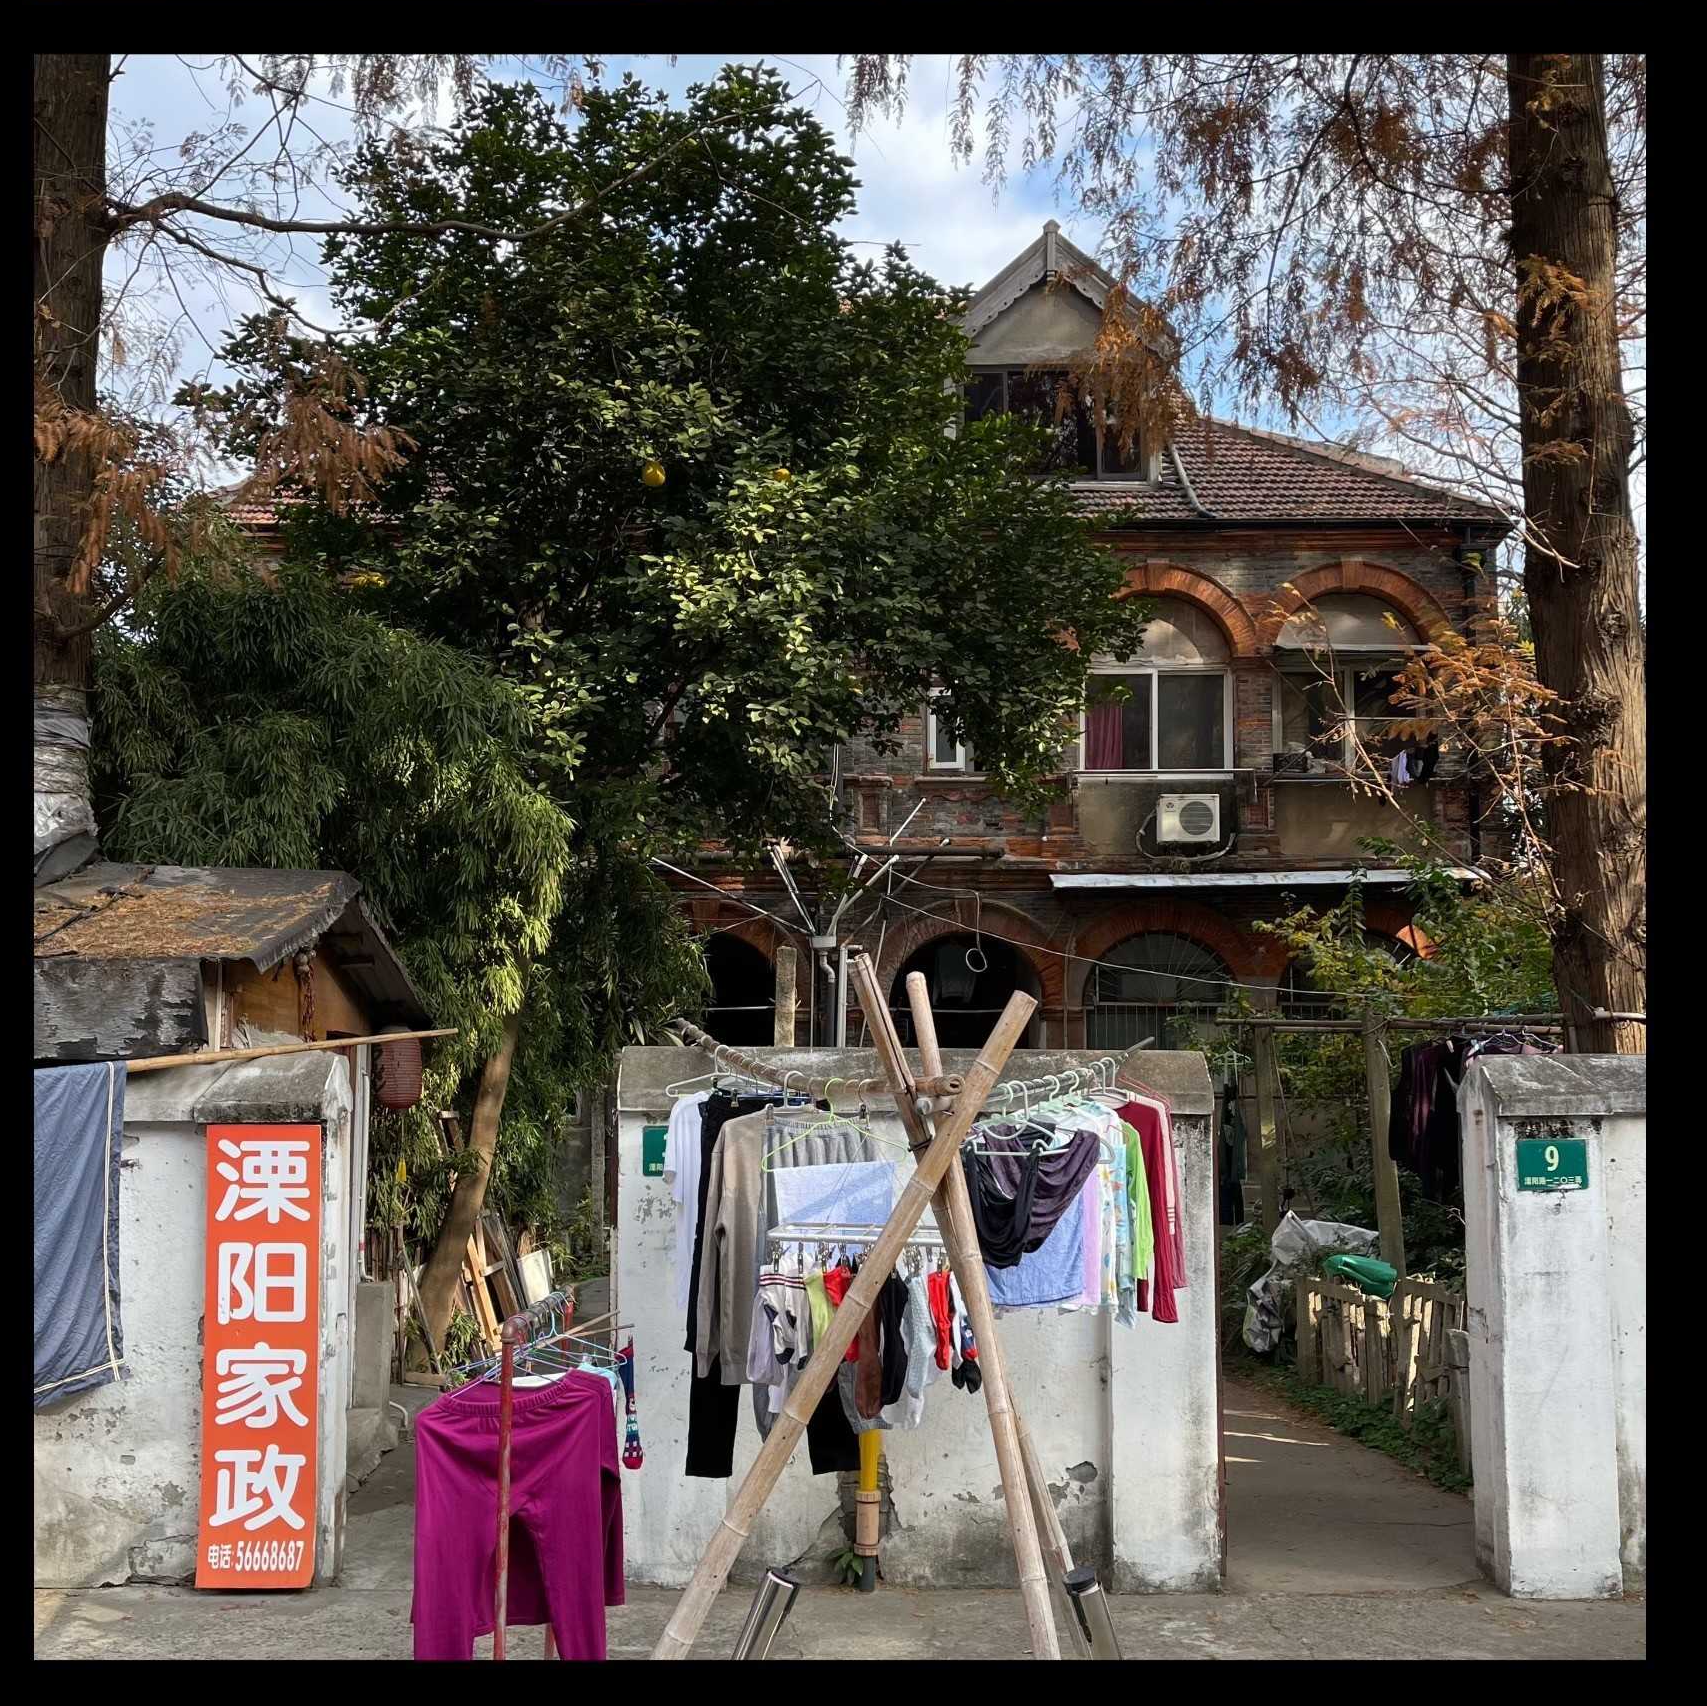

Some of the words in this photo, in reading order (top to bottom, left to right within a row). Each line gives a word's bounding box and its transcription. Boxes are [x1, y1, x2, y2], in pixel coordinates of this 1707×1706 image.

[1545, 1145, 1559, 1172] 9
[208, 1138, 311, 1531] 溧阳家政
